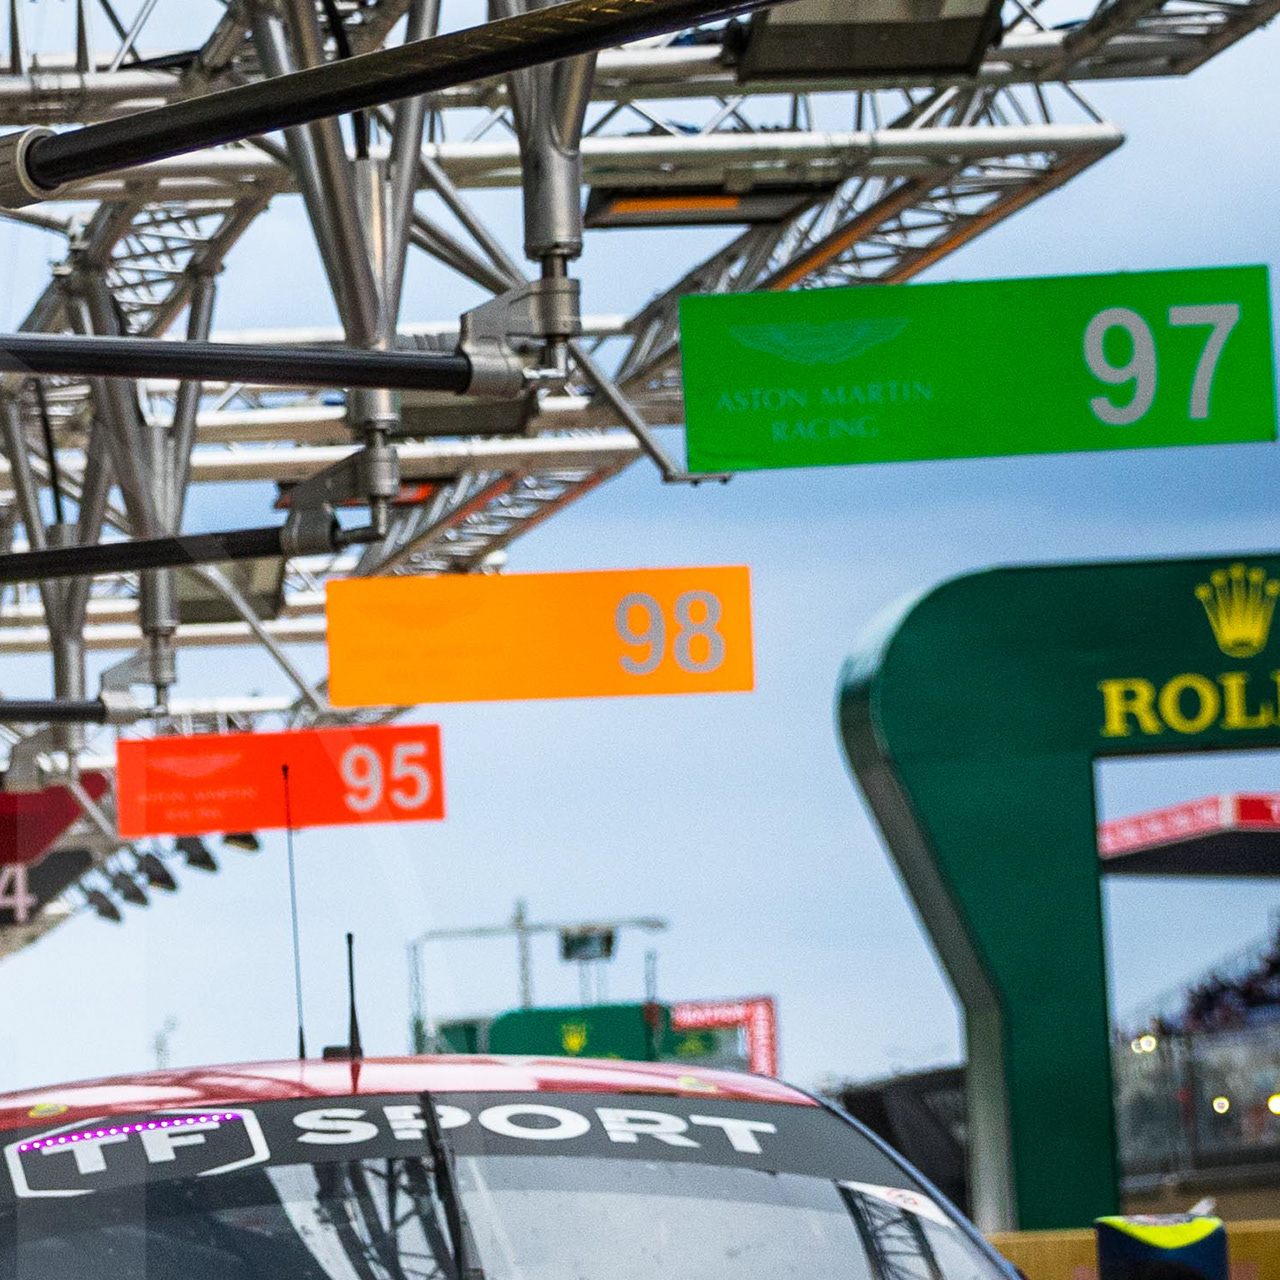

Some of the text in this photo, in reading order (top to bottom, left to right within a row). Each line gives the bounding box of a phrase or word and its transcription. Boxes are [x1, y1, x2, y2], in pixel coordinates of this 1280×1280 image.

[715, 380, 934, 412] ASTON MARTIN
[1082, 302, 1240, 426] 97
[771, 416, 879, 443] RACING
[613, 589, 726, 676] 98
[1097, 671, 1280, 738] ROL
[341, 742, 432, 813] 95
[41, 1101, 778, 1176] TF SPORT
